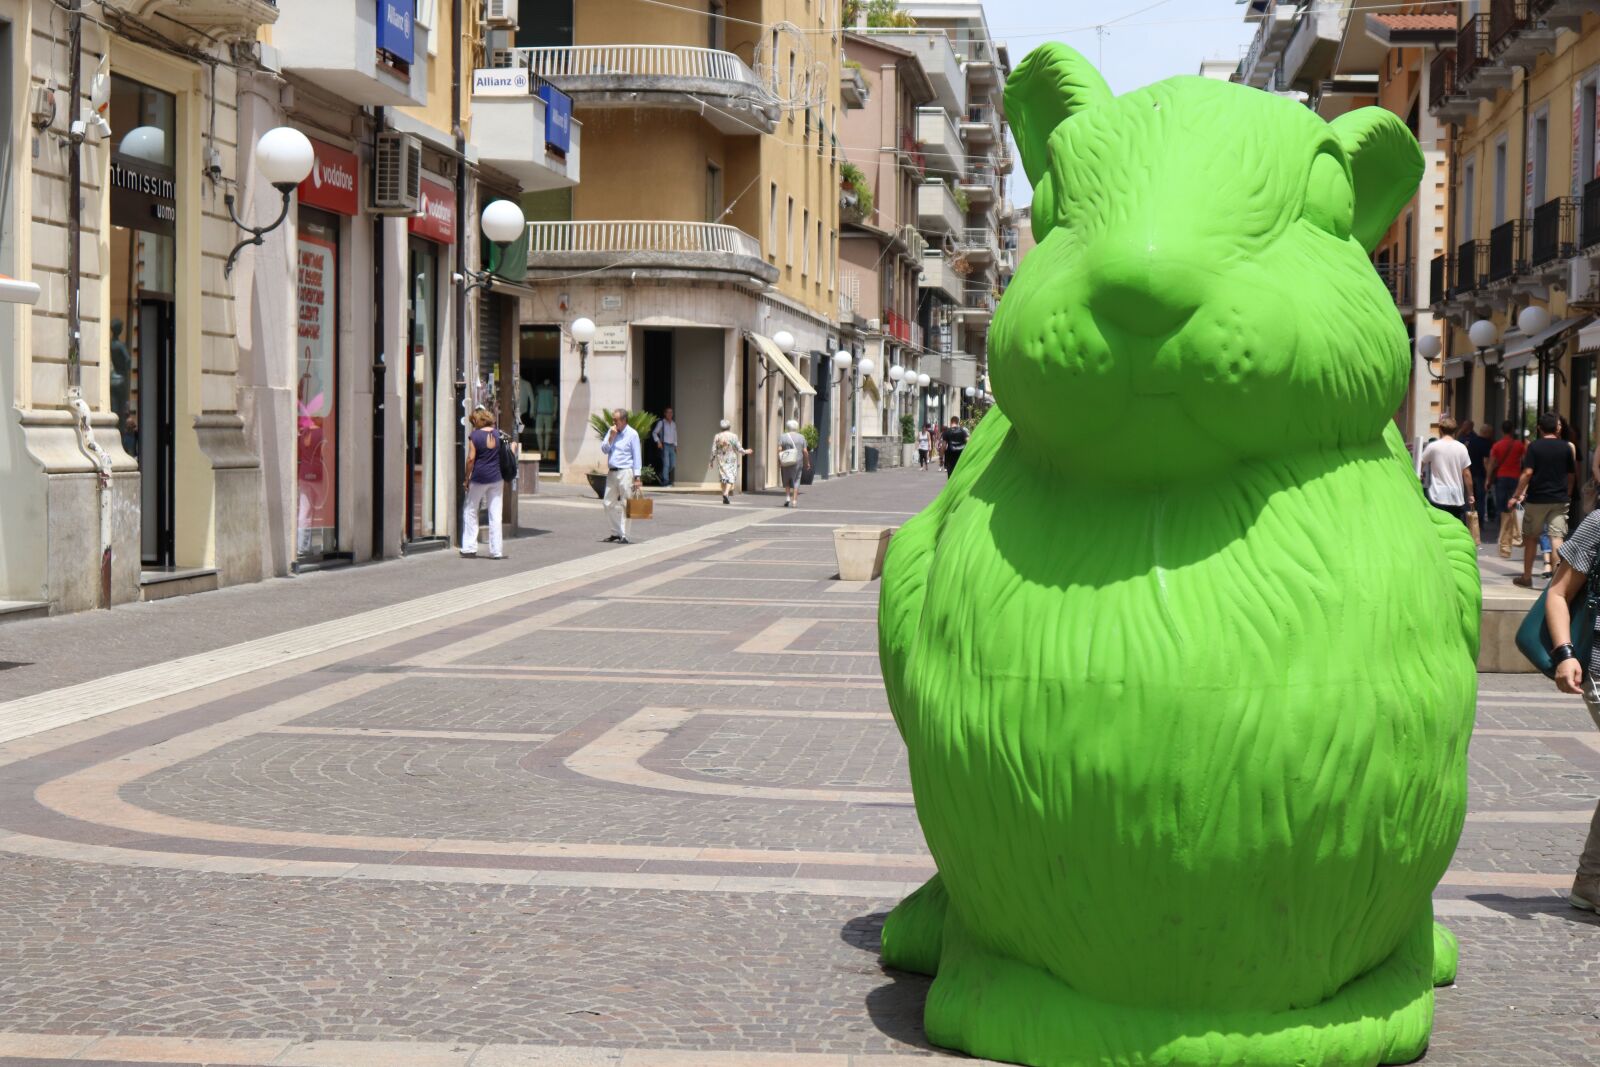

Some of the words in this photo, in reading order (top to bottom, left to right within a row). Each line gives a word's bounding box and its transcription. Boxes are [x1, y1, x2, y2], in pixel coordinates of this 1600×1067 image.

[387, 3, 404, 31] Allianz
[476, 76, 512, 87] Allianz
[323, 162, 353, 192] vodafone
